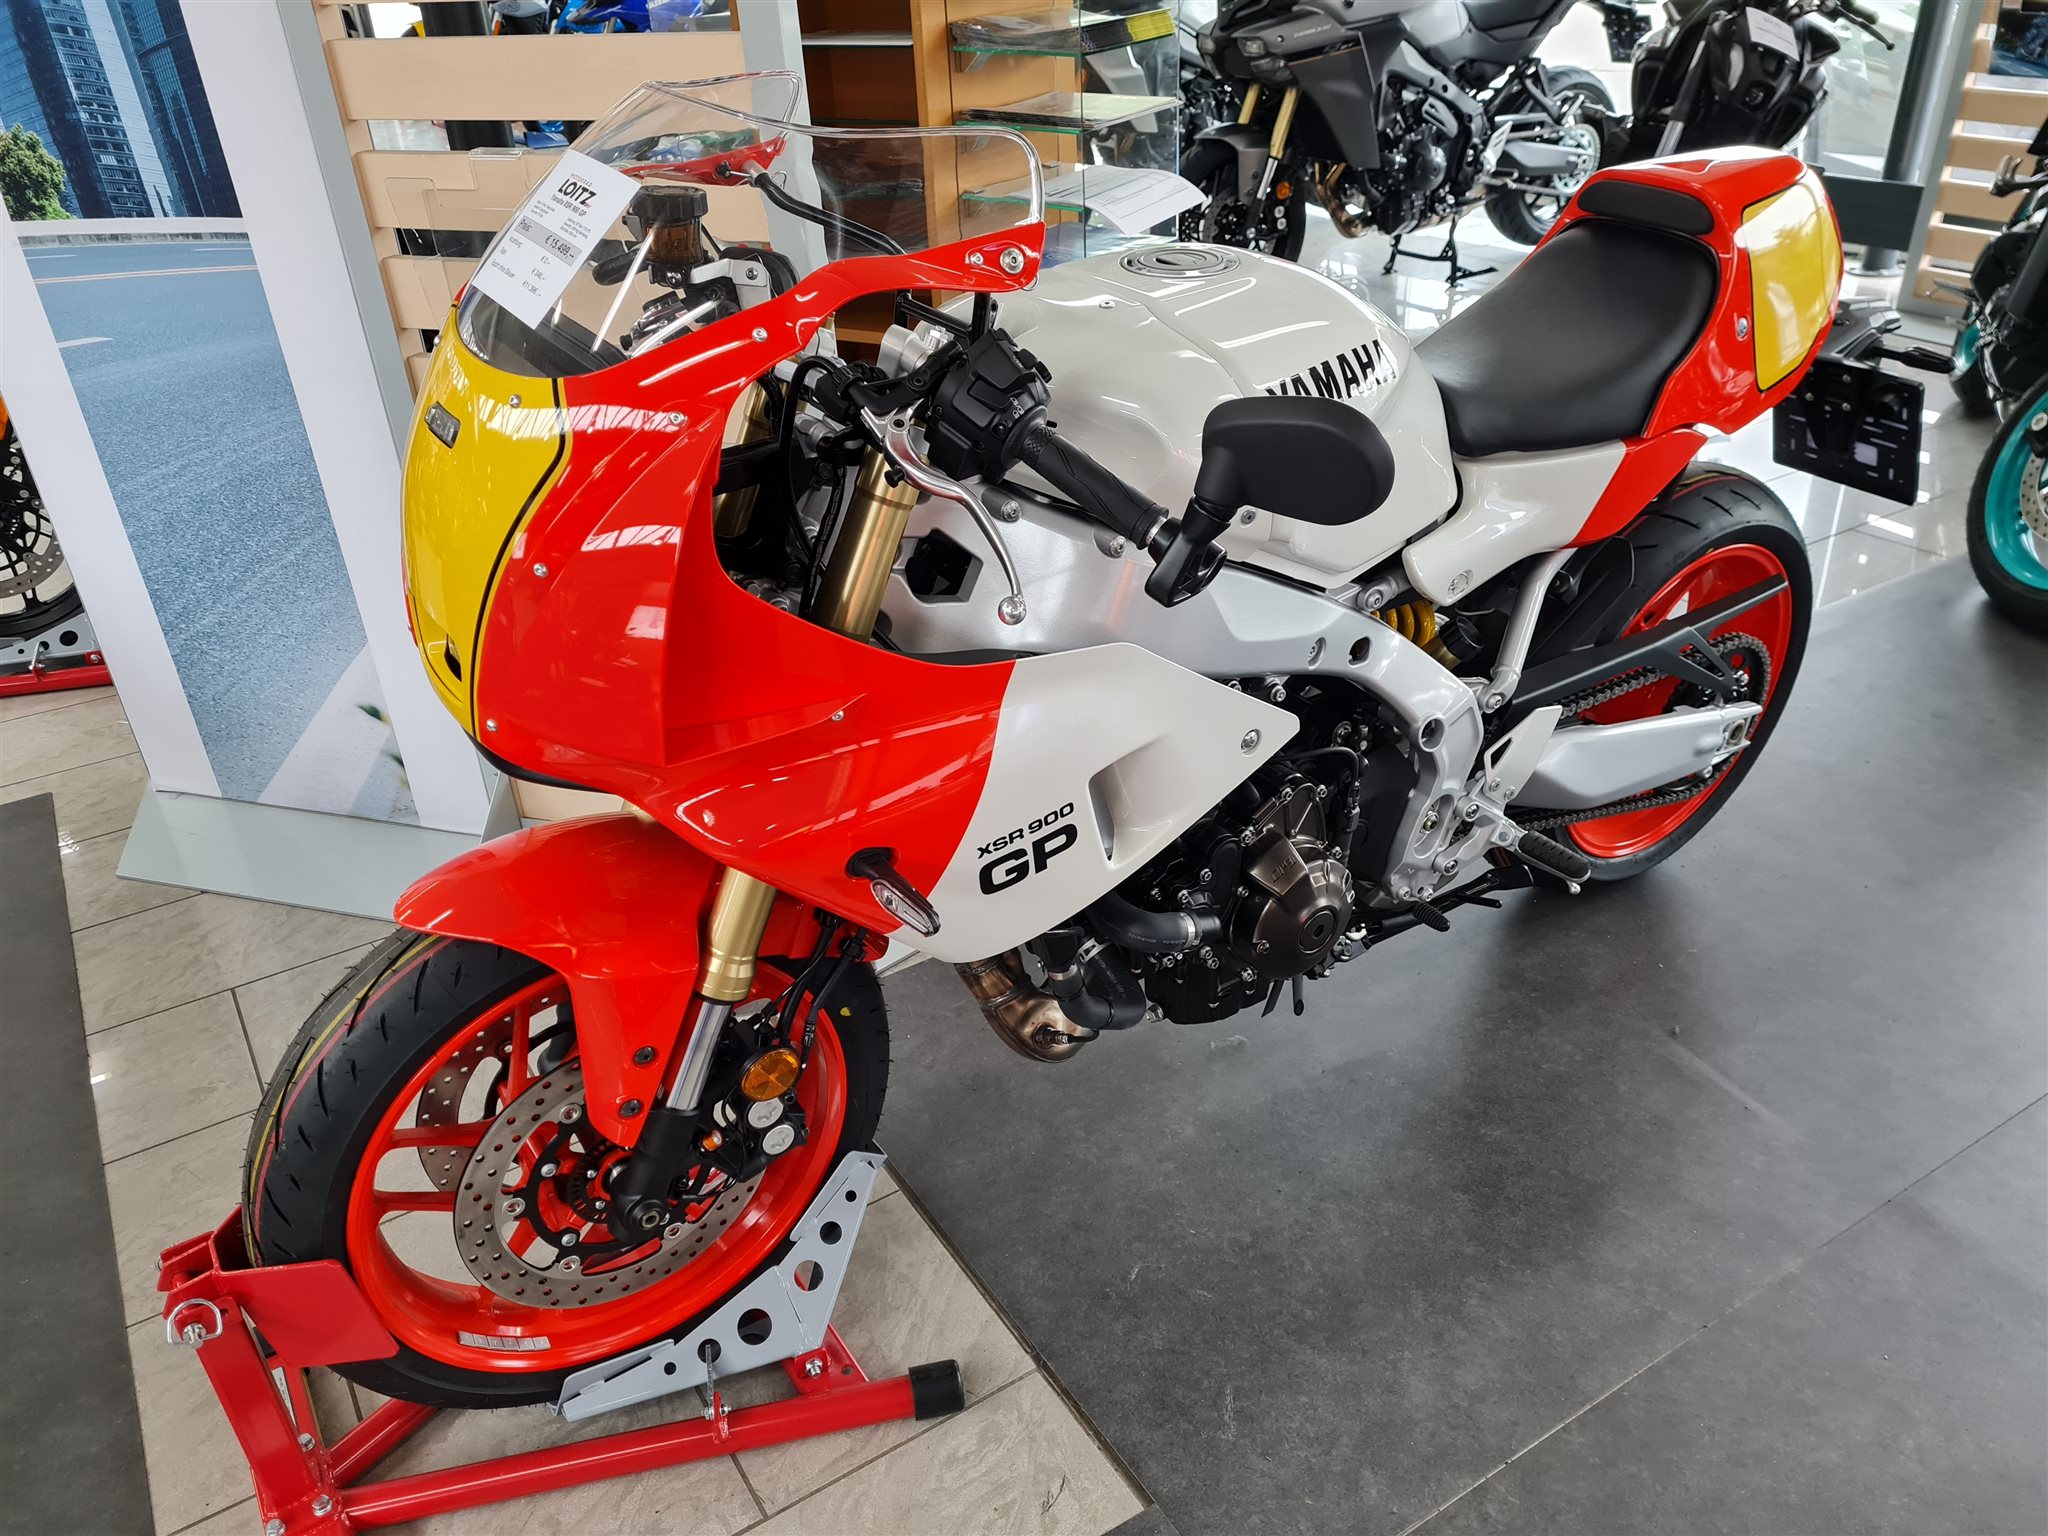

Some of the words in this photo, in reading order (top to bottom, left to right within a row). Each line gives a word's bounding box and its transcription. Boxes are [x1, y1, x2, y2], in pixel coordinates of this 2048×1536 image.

[557, 178, 597, 205] LOITZ
[578, 209, 587, 217] GP
[1265, 339, 1397, 402] AMAHA
[976, 828, 1025, 859] XSR
[1028, 802, 1074, 834] 900
[979, 823, 1078, 895] GP
